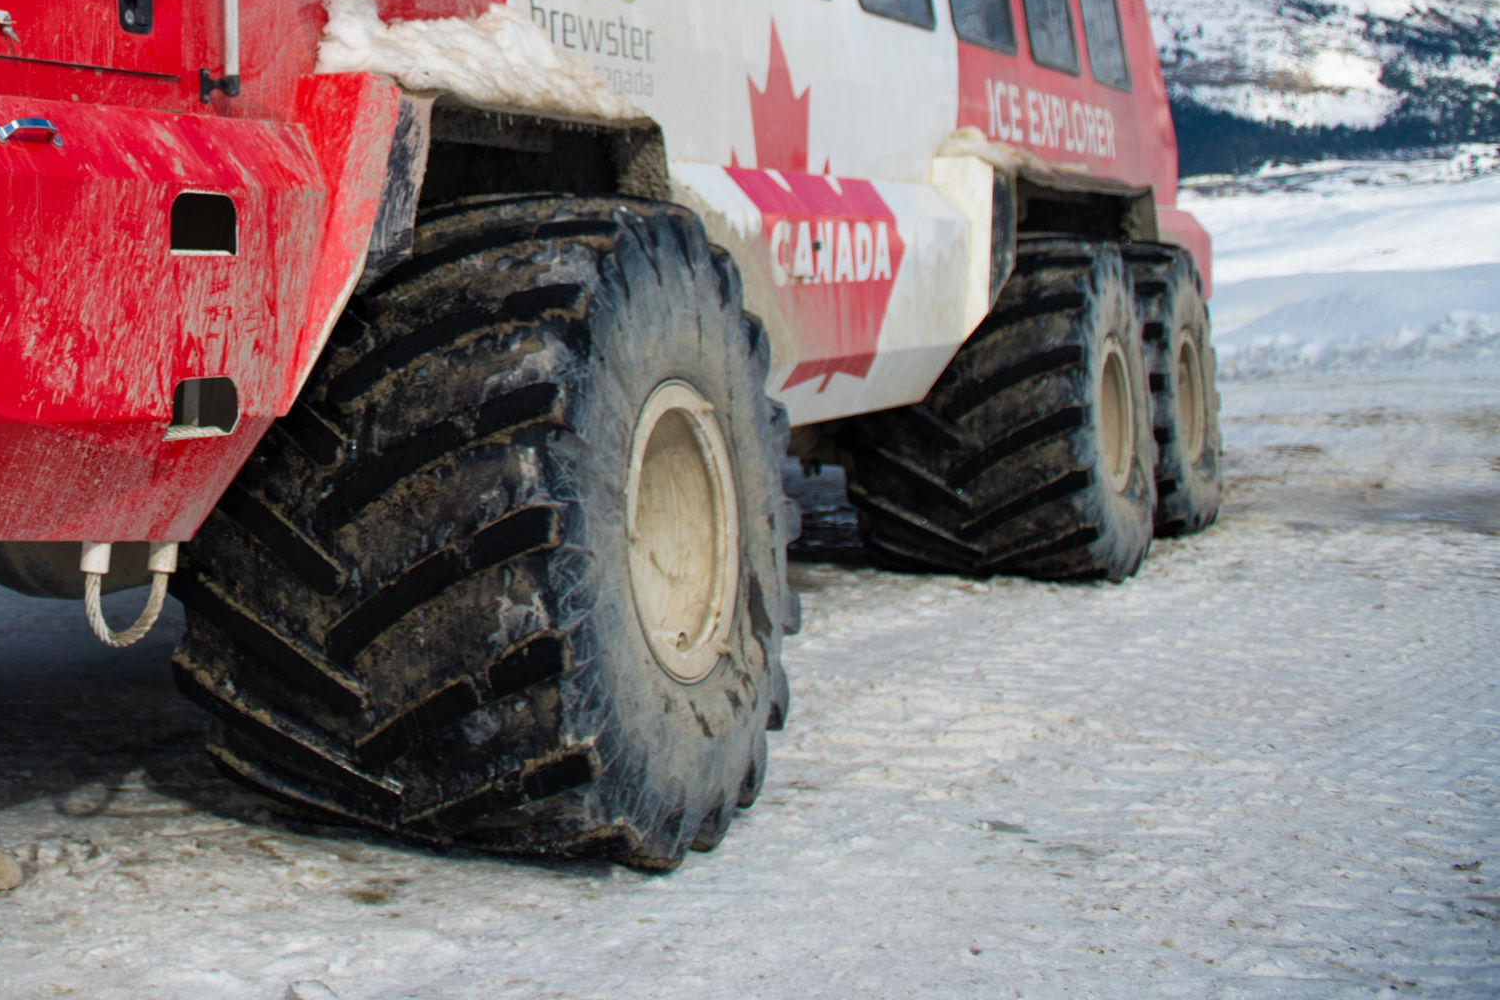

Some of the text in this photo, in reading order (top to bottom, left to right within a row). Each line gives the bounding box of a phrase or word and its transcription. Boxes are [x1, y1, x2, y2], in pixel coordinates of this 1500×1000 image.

[986, 78, 1116, 159] ICE EXPLORER
[771, 220, 892, 287] CANADA
